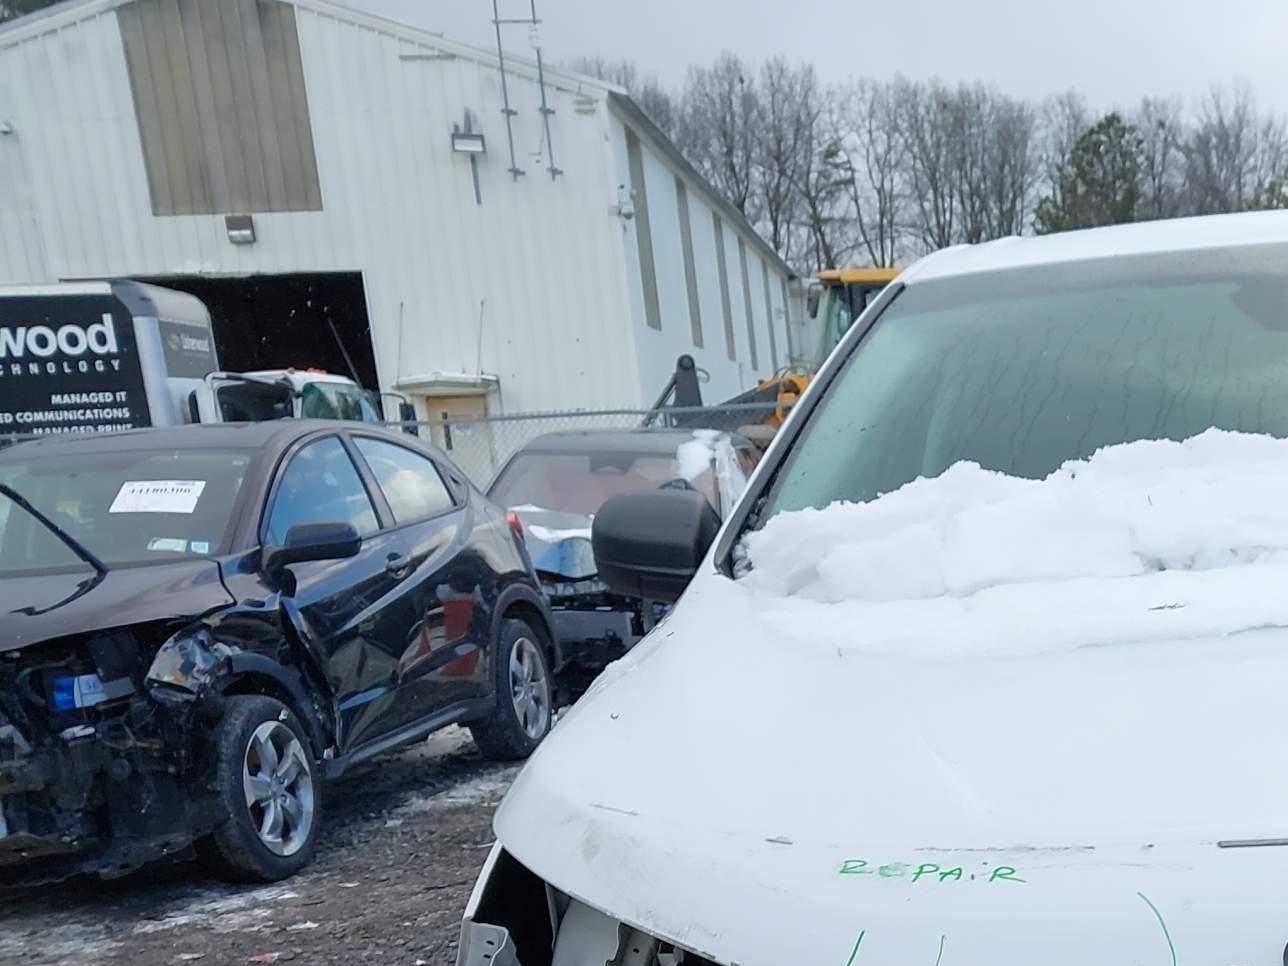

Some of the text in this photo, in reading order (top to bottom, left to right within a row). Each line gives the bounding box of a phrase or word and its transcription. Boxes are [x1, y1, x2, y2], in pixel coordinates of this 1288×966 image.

[51, 391, 127, 404] MANAGED IT
[15, 407, 131, 423] COMMUNICATIONS
